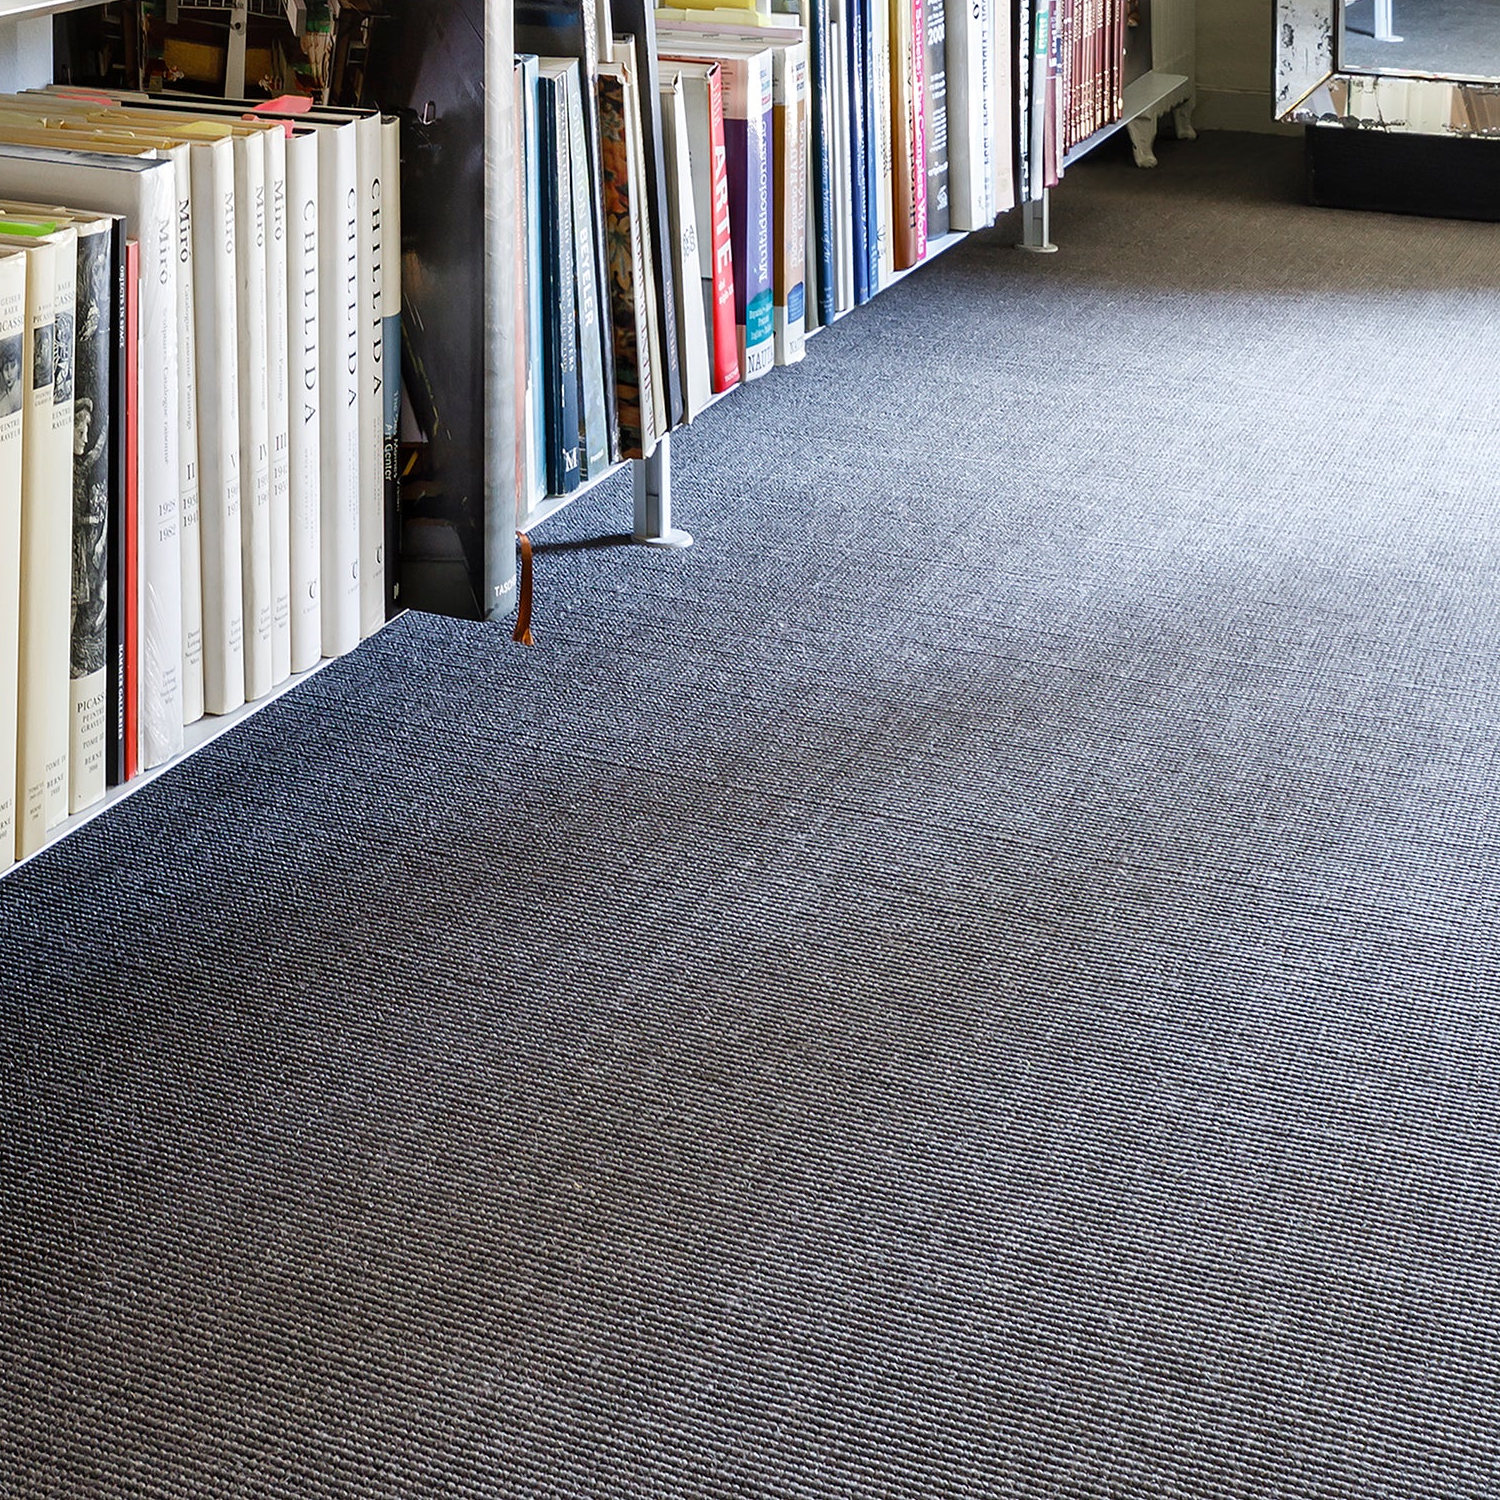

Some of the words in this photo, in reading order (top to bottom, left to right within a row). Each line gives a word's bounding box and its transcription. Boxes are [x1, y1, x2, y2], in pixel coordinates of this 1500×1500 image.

[915, 114, 924, 199] Complete
[179, 199, 191, 264] Miró
[570, 92, 586, 217] FONDATION
[579, 226, 594, 328] BEYELER
[713, 145, 733, 274] ARTE
[758, 120, 768, 284] Multidiccionario
[917, 199, 925, 255] Works
[158, 219, 171, 285] Miró
[371, 177, 382, 395] CHILLIDA
[303, 199, 316, 424] CHILLIDA
[347, 187, 357, 408] CHILLIDA
[385, 424, 393, 440] Art
[385, 444, 393, 481] Center
[562, 447, 577, 473] M
[187, 462, 195, 480] II
